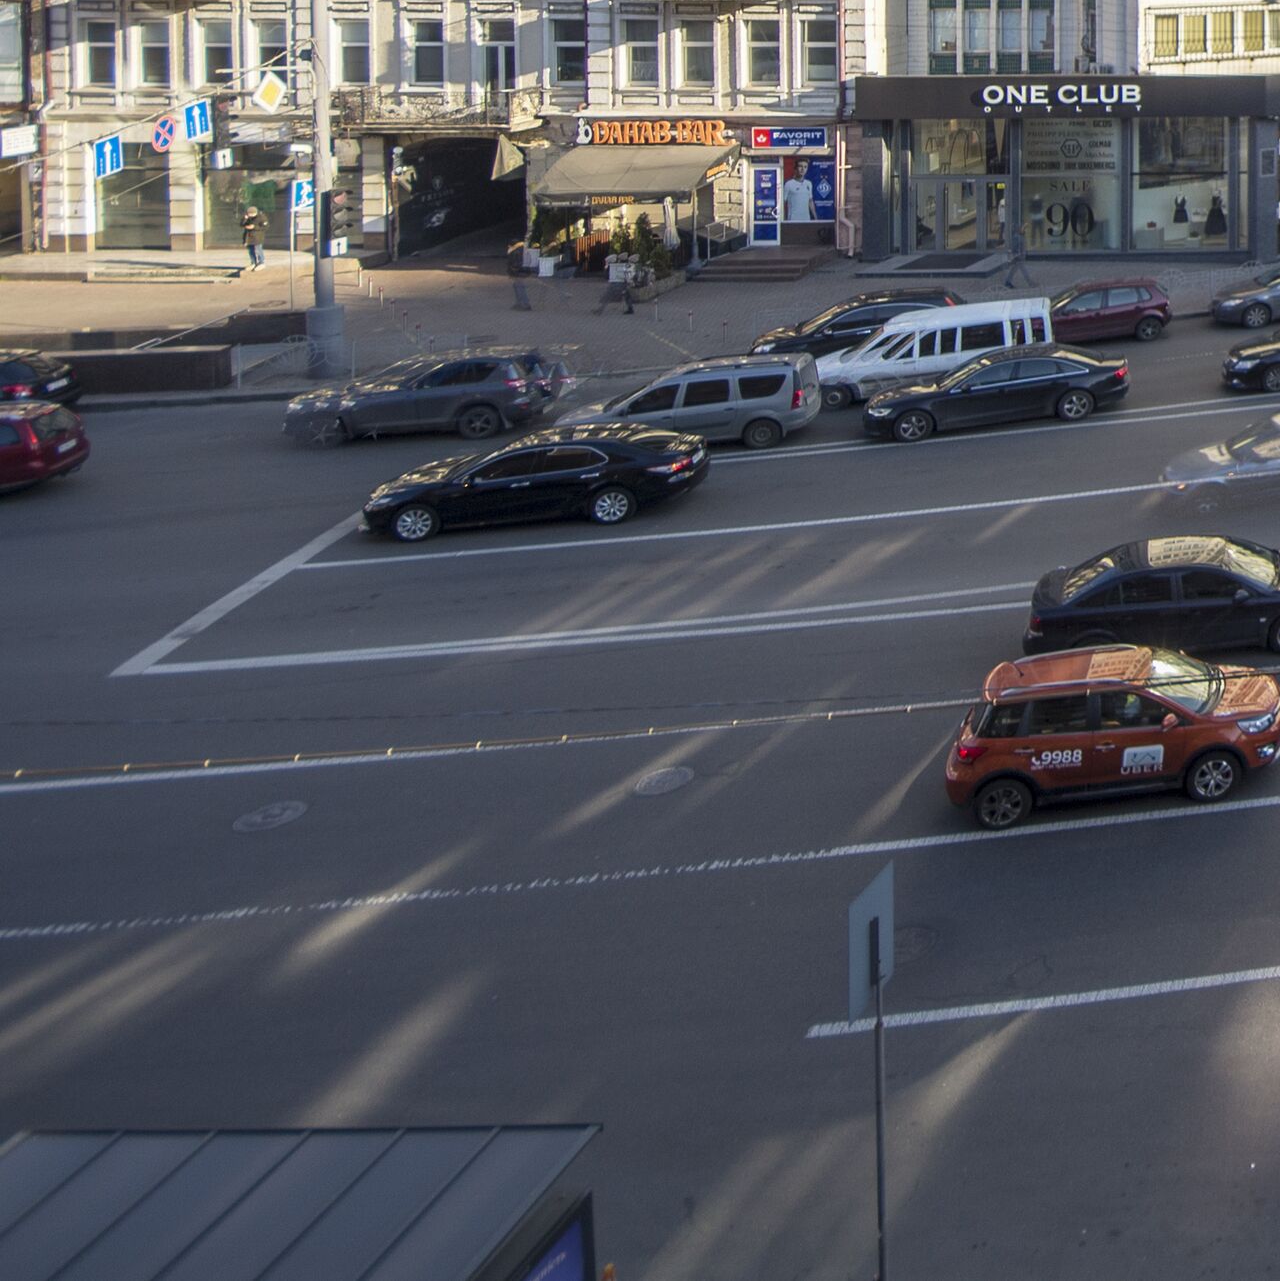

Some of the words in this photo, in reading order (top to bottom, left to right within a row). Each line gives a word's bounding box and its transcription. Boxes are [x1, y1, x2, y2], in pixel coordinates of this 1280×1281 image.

[983, 85, 1049, 104] ONE
[1057, 84, 1142, 104] CLUB
[591, 121, 671, 144] DAHAB
[675, 119, 730, 146] BAR
[1049, 180, 1091, 192] SALE
[1046, 203, 1094, 237] 90
[1041, 749, 1083, 765] 9988
